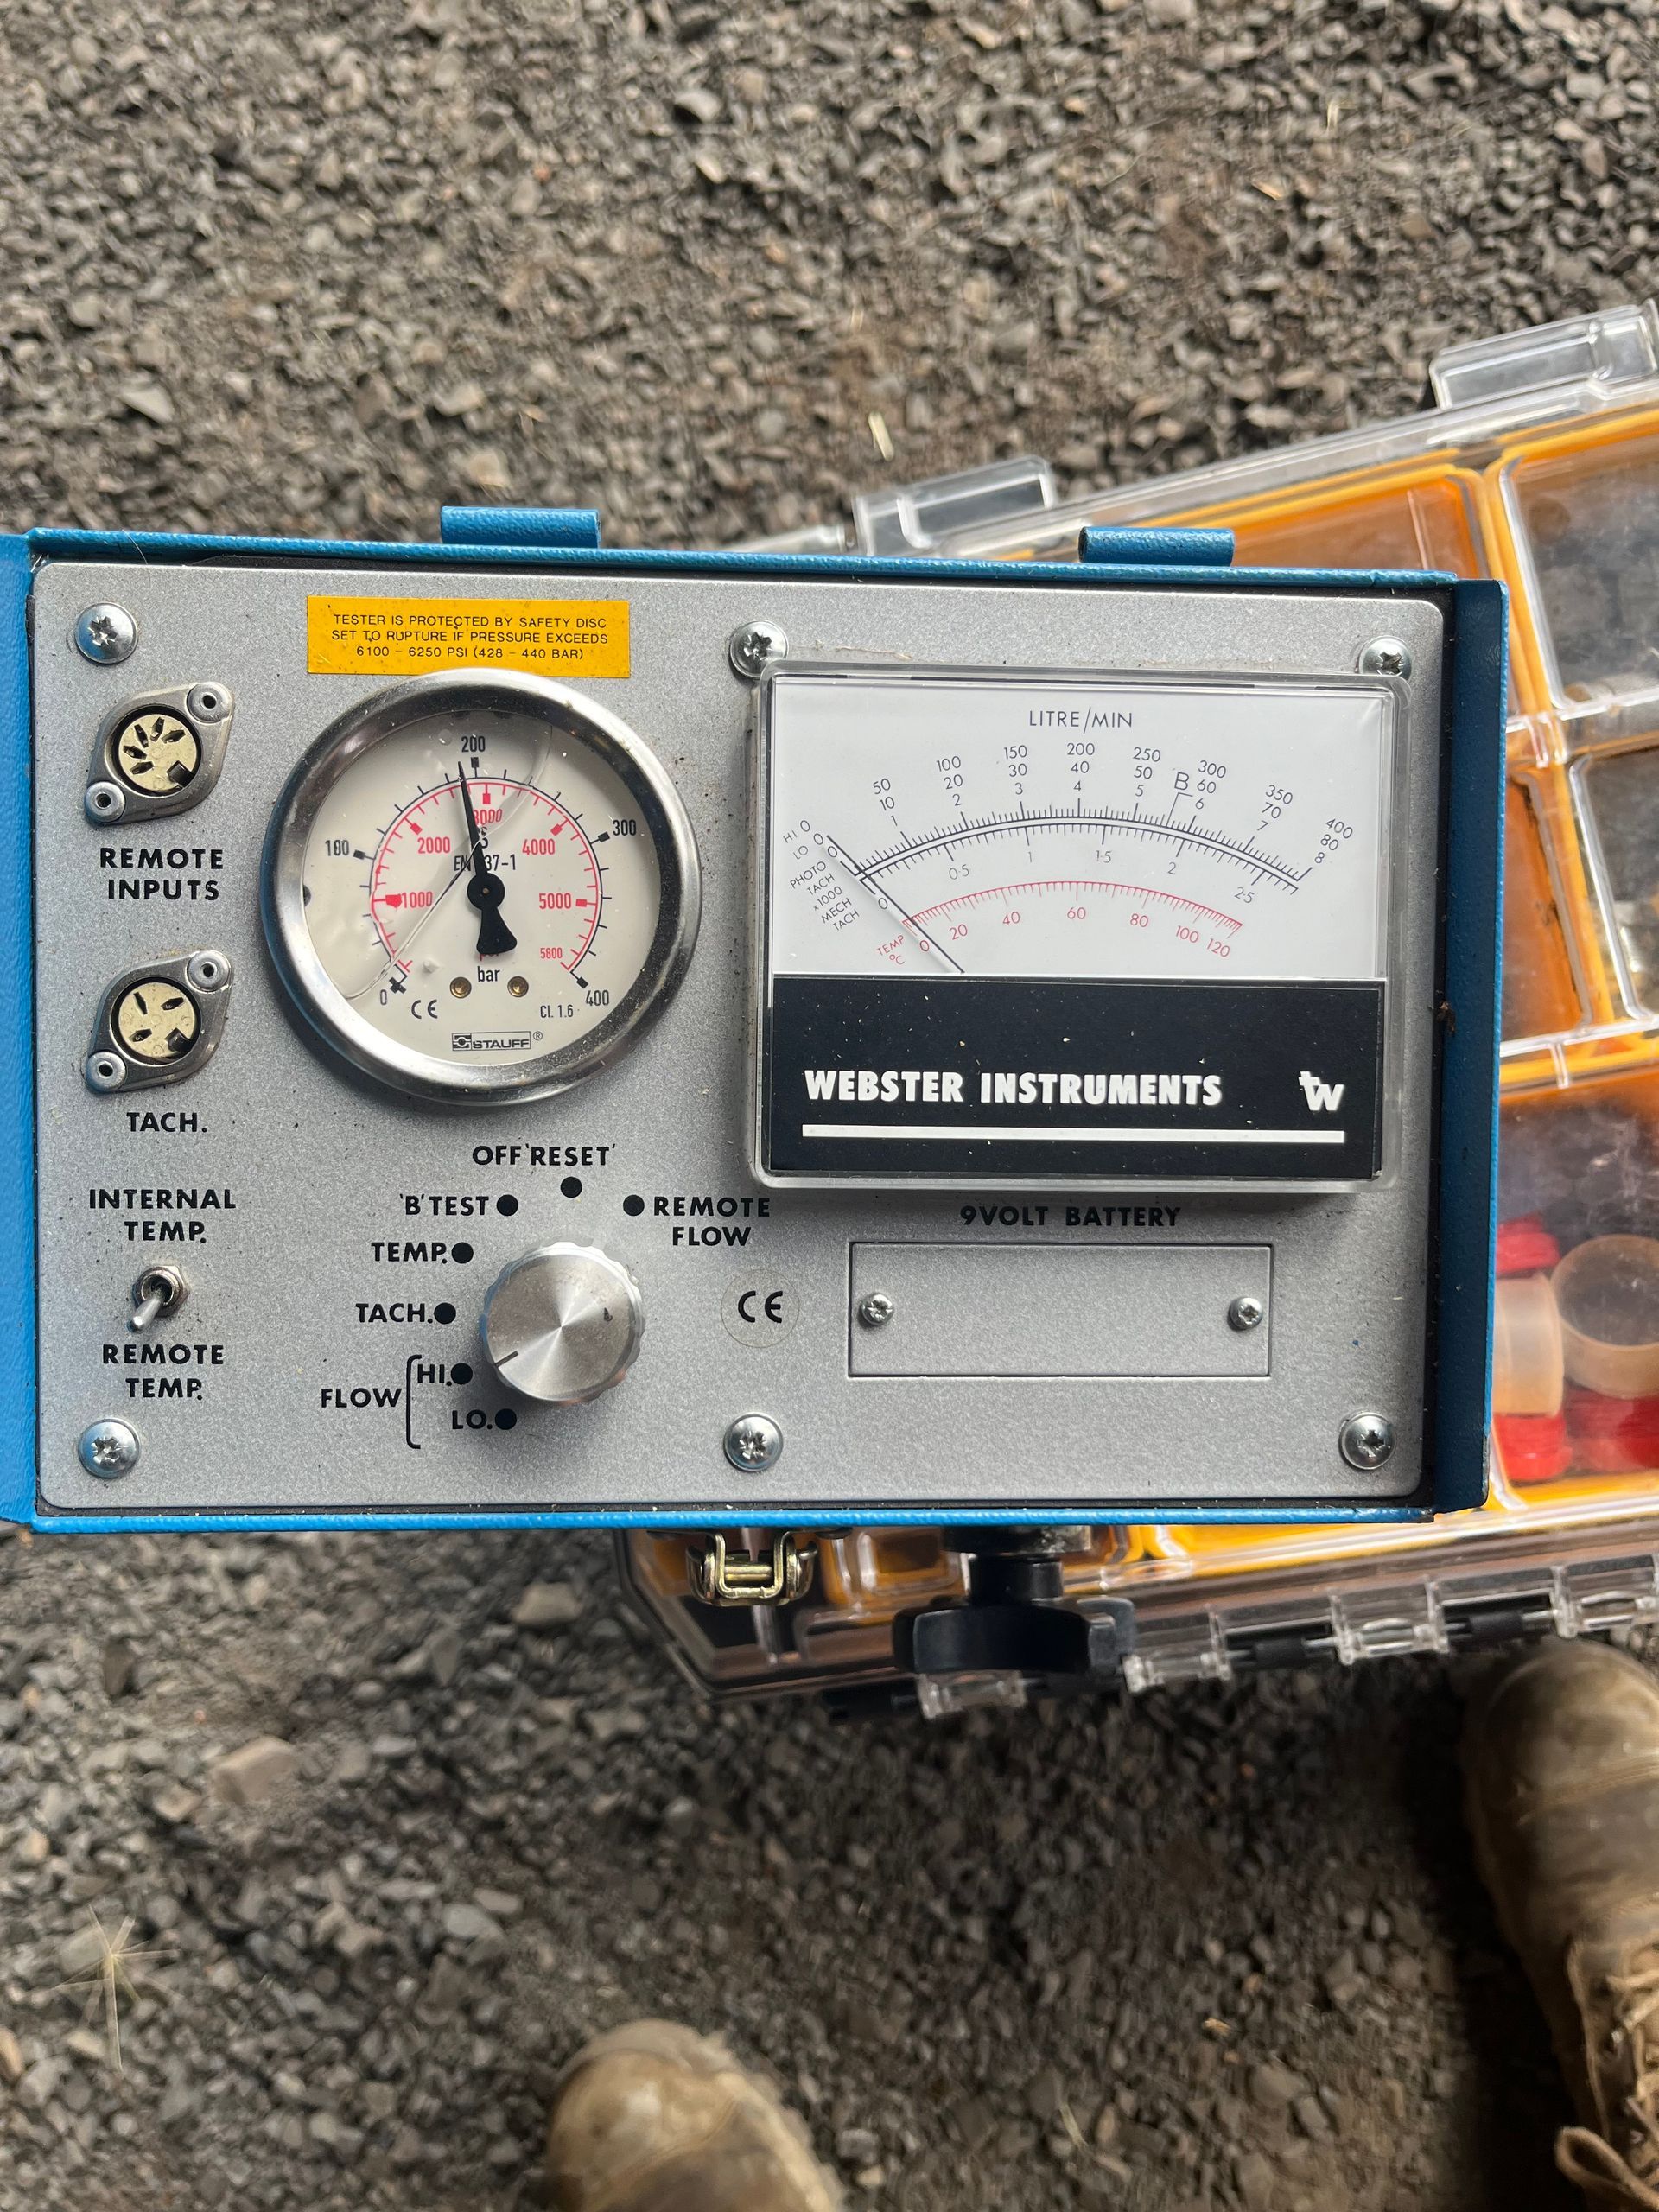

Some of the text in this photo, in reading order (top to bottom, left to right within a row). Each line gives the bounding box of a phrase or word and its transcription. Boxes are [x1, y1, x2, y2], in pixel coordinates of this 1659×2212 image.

[334, 614, 607, 628] TESTER IS PROTECTED BY SAFETY DISC
[331, 631, 608, 644] SET TO RUPTURE IF PRESSURE EXCEEDS
[356, 645, 390, 657] 6100
[409, 646, 442, 658] 6250
[448, 647, 467, 658] PSI
[474, 647, 504, 660] (428
[522, 648, 546, 659] 440
[551, 649, 583, 660] BAR)
[1030, 707, 1132, 734] LITRE/MIN
[461, 736, 486, 752] 200
[1004, 745, 1028, 760] 150
[1067, 742, 1095, 756] 200
[936, 755, 962, 772] 100
[1133, 747, 1161, 763] 250
[1008, 763, 1027, 778] 30
[1071, 760, 1090, 774] 40
[1134, 765, 1153, 779] 50
[1198, 760, 1227, 779] 300
[873, 778, 891, 795] 50
[943, 774, 963, 790] 20
[1014, 782, 1024, 795] 3
[1073, 780, 1082, 792] 4
[1174, 772, 1190, 791] B
[1197, 779, 1217, 794] 60
[1135, 784, 1145, 797] 5
[1266, 784, 1294, 805] 350
[880, 796, 895, 811] 10
[952, 793, 962, 806] 2
[1195, 798, 1205, 810] 6
[1261, 802, 1281, 819] 70
[612, 820, 637, 836] 300
[782, 820, 810, 844] HI 0
[1256, 820, 1268, 832] 7
[1325, 818, 1353, 840] 400
[325, 839, 350, 856] 100
[417, 836, 451, 855] 2000
[522, 839, 556, 855] 4000
[793, 833, 824, 860] LO 0
[1320, 833, 1339, 851] 80
[99, 847, 224, 869] REMOTE
[481, 854, 516, 871] 37-1
[1314, 851, 1325, 864] 8
[790, 845, 838, 889] PHOTO 0
[1166, 861, 1176, 875] 2
[108, 879, 219, 901] INPUTS
[805, 873, 836, 896] TACH
[401, 891, 433, 908] 1000
[538, 893, 572, 909] 5000
[821, 897, 852, 924] MECH
[832, 897, 888, 931] TACH 0
[1002, 911, 1021, 925] 40
[1066, 906, 1086, 920] 60
[1129, 912, 1149, 928] 80
[949, 923, 968, 941] 20
[1175, 925, 1199, 944] 100
[540, 947, 563, 959] 5800
[876, 934, 905, 957] TEMP
[919, 939, 930, 952] 0
[1205, 938, 1230, 958] 120
[477, 966, 500, 982] bar
[379, 989, 388, 1005] 0
[585, 990, 609, 1006] 400
[557, 1005, 574, 1018] 1.6
[472, 1039, 530, 1049] STAUFF
[804, 1069, 1223, 1106] WEBSTER INSTRUMENTS
[126, 1112, 207, 1133] TACH.
[472, 1145, 522, 1166] OFF
[89, 1188, 236, 1210] INTERNAL
[429, 1195, 490, 1217] TEST
[653, 1197, 771, 1217] REMOTE
[1065, 1206, 1181, 1229] BATTERY
[124, 1221, 207, 1244] TEMP.
[672, 1226, 752, 1247] FLOW
[371, 1242, 448, 1264] TEMP.
[355, 1303, 433, 1324] TACH.
[102, 1344, 225, 1365] REMOTE
[125, 1377, 202, 1401] TEMP.
[321, 1388, 402, 1409] FLOW
[451, 1409, 493, 1430] LO.
